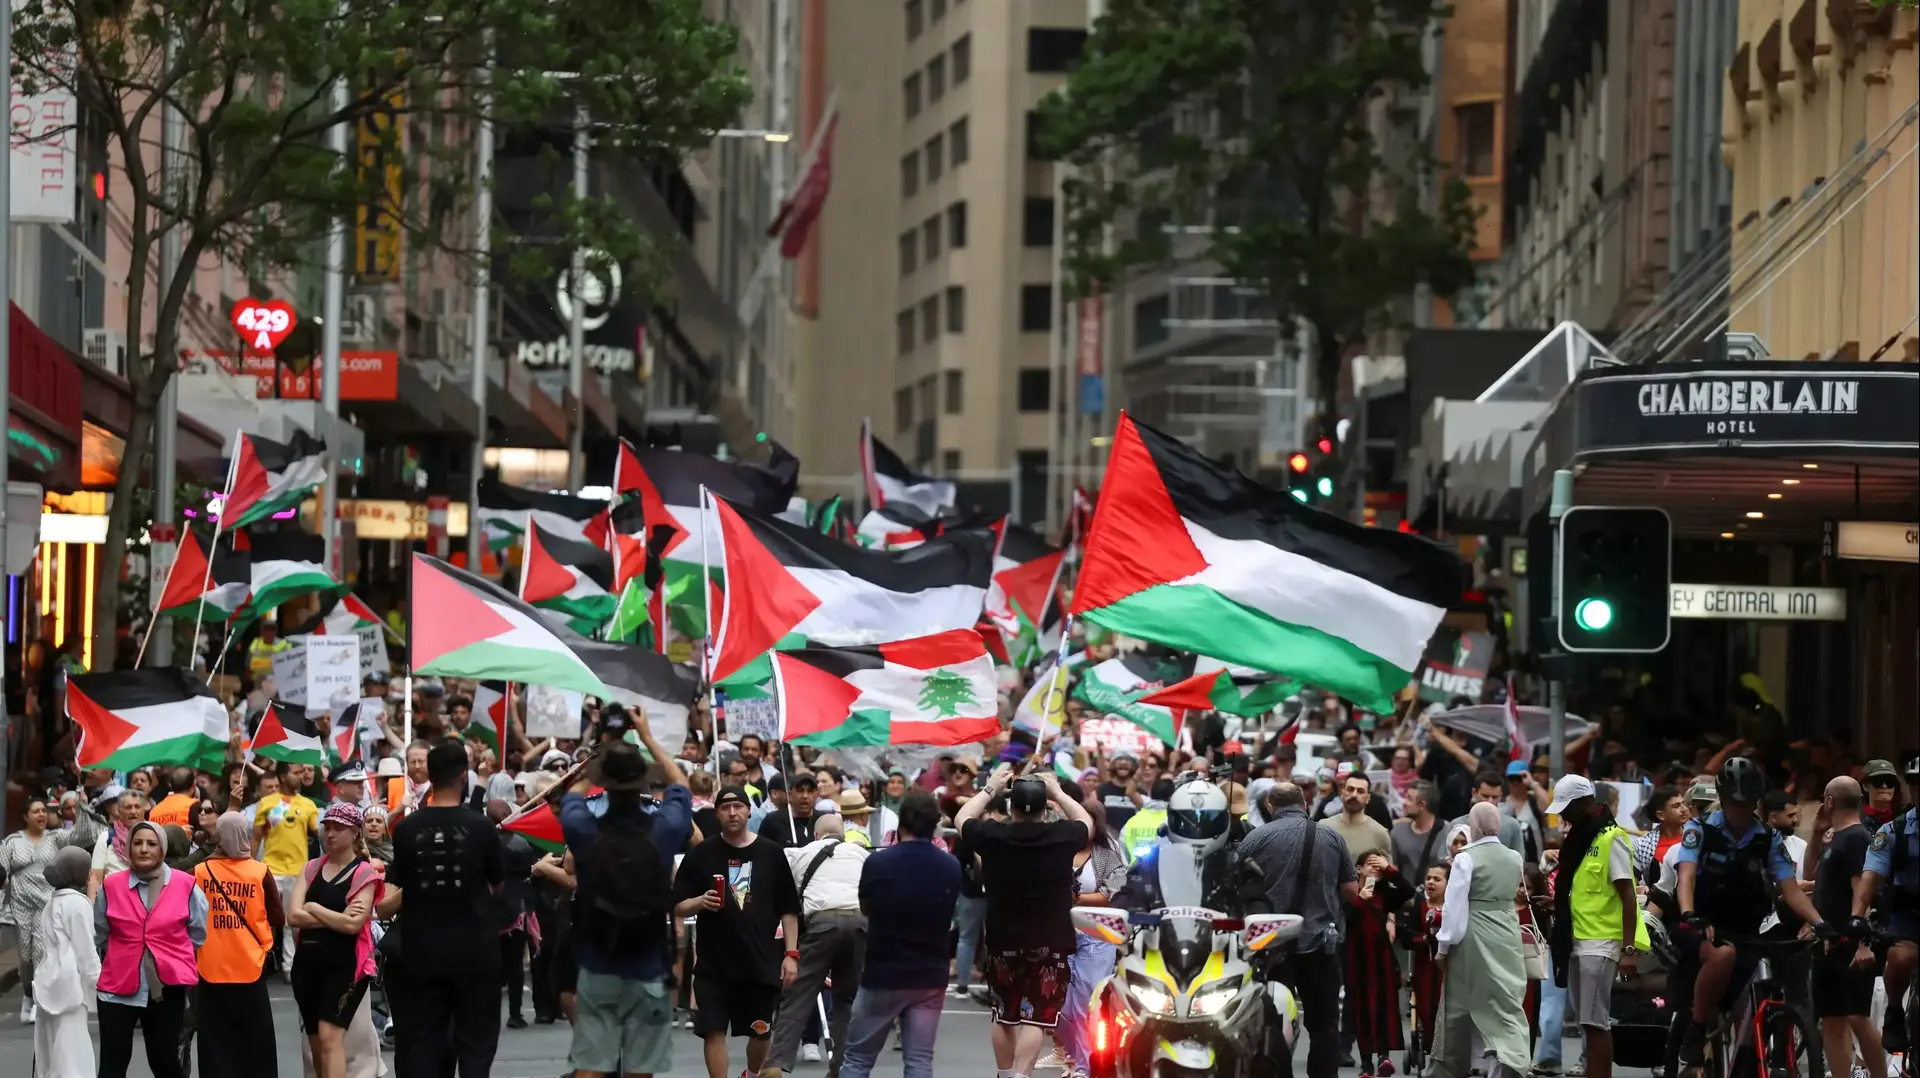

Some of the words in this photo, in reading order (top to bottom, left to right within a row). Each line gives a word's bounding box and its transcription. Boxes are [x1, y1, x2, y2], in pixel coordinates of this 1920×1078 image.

[41, 100, 66, 198] HOTEL
[236, 307, 290, 332] 429
[254, 331, 272, 349] A
[1638, 380, 1859, 415] CHAMBERLAIN
[1706, 420, 1756, 434] HOTEL
[1823, 521, 1833, 556] BAR
[1704, 591, 1778, 613] CENTRAL
[1787, 593, 1817, 615] INN
[1421, 667, 1483, 697] LIVES
[203, 879, 256, 898] PALESTINE
[1160, 908, 1214, 919] Police
